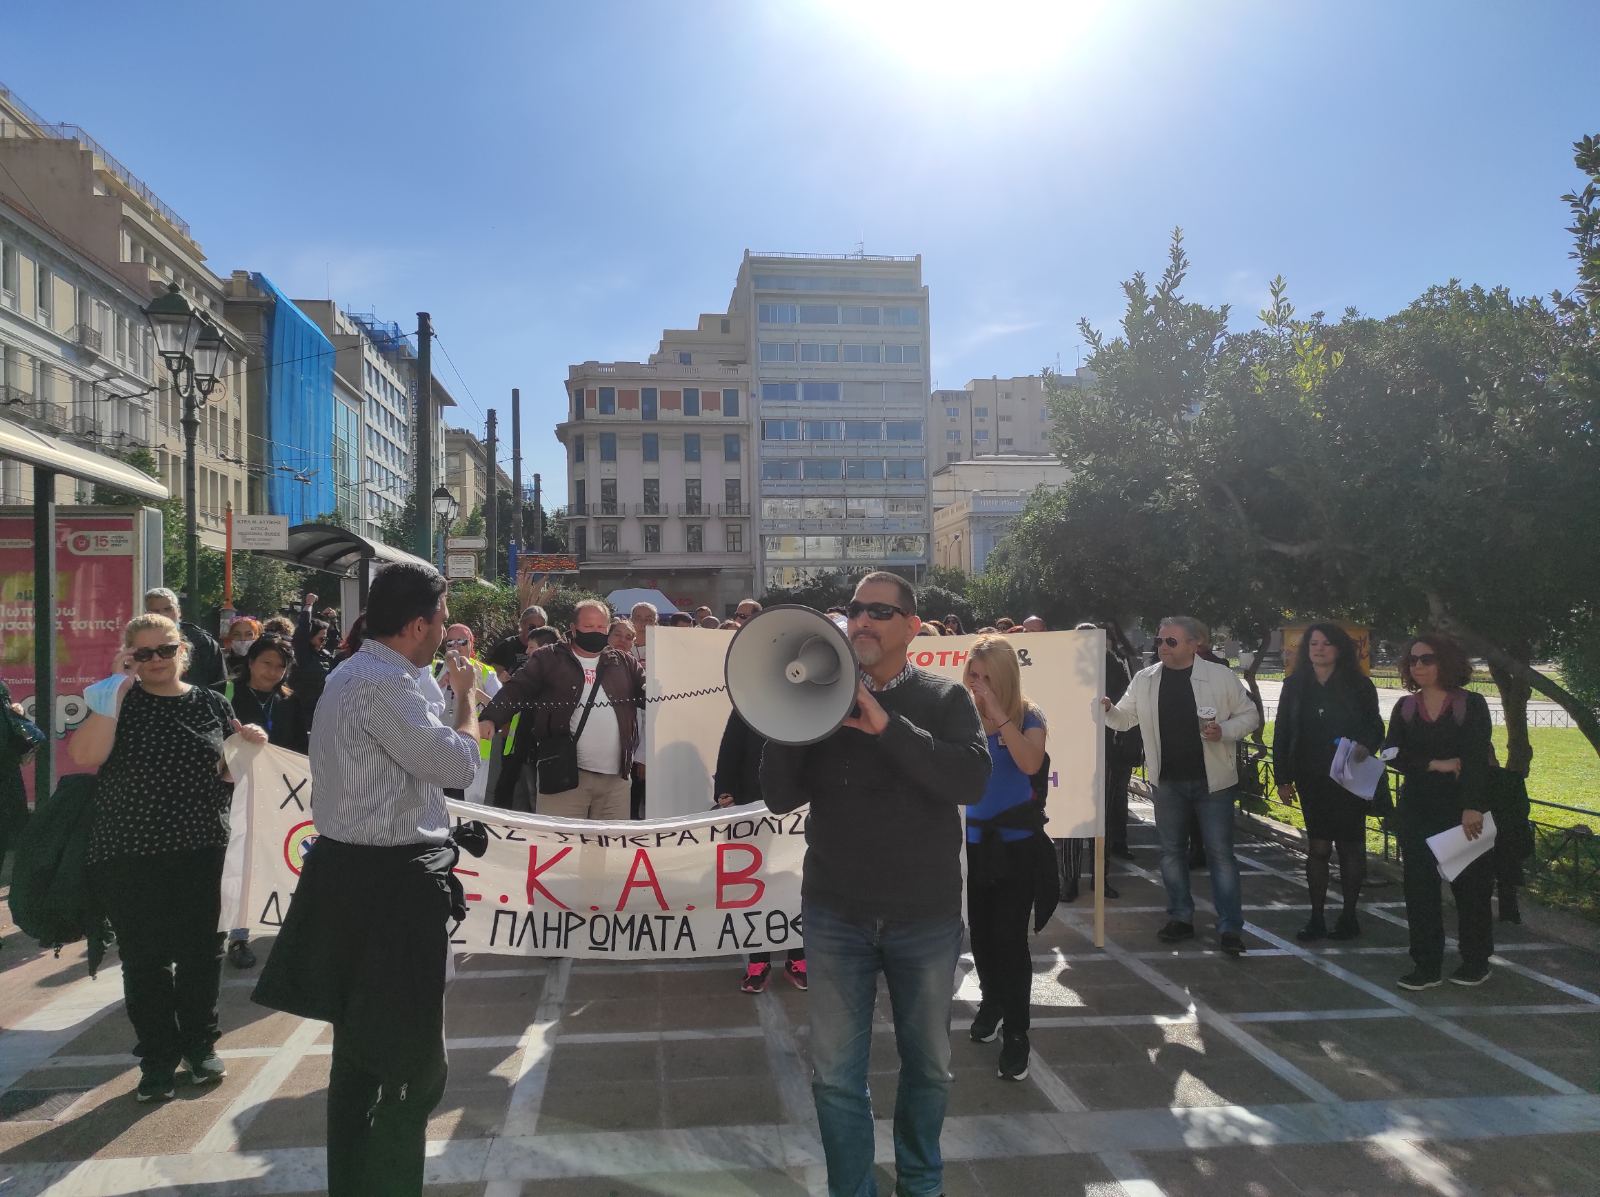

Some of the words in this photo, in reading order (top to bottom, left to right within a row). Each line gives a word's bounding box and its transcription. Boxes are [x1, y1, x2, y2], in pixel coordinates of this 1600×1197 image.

[95, 535, 109, 547] 15
[1017, 649, 1033, 666] &
[490, 909, 697, 952] ΠΛΗΡΩΜΑΤΑ
